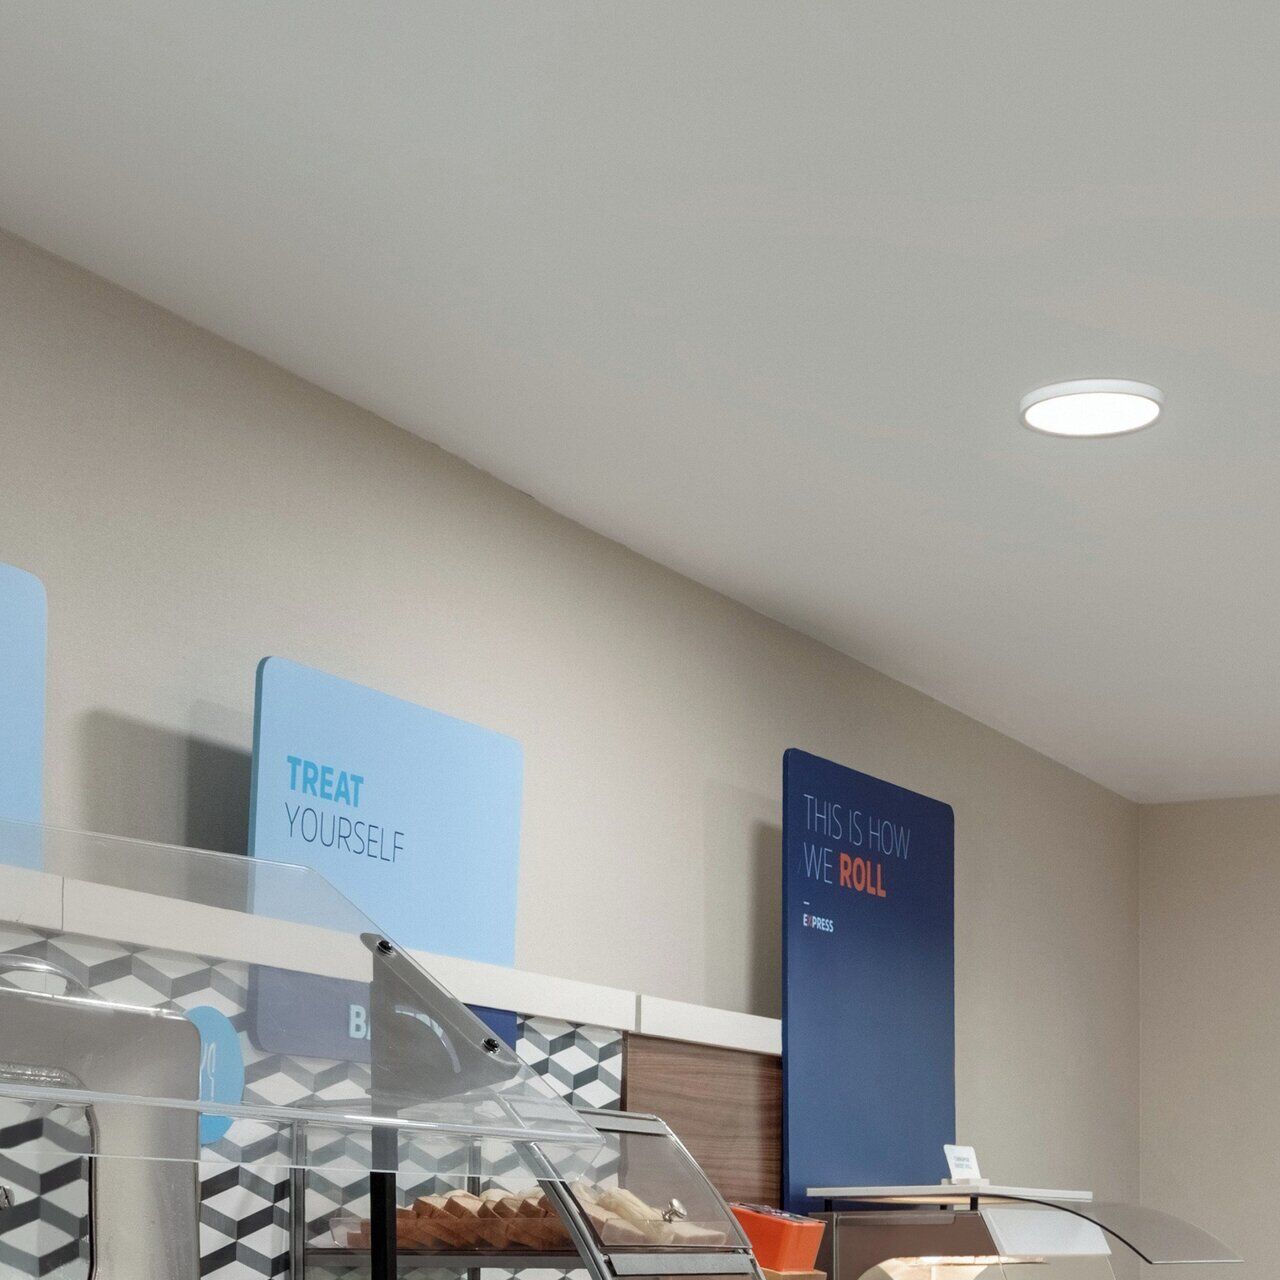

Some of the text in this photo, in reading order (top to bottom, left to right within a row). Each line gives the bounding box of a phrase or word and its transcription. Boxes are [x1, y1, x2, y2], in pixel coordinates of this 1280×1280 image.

[286, 754, 365, 808] TREAT
[284, 801, 405, 863] YOURSELF
[803, 793, 911, 860] THIS IS HOW
[803, 842, 887, 898] WE ROLL
[802, 913, 834, 933] EXPRESS
